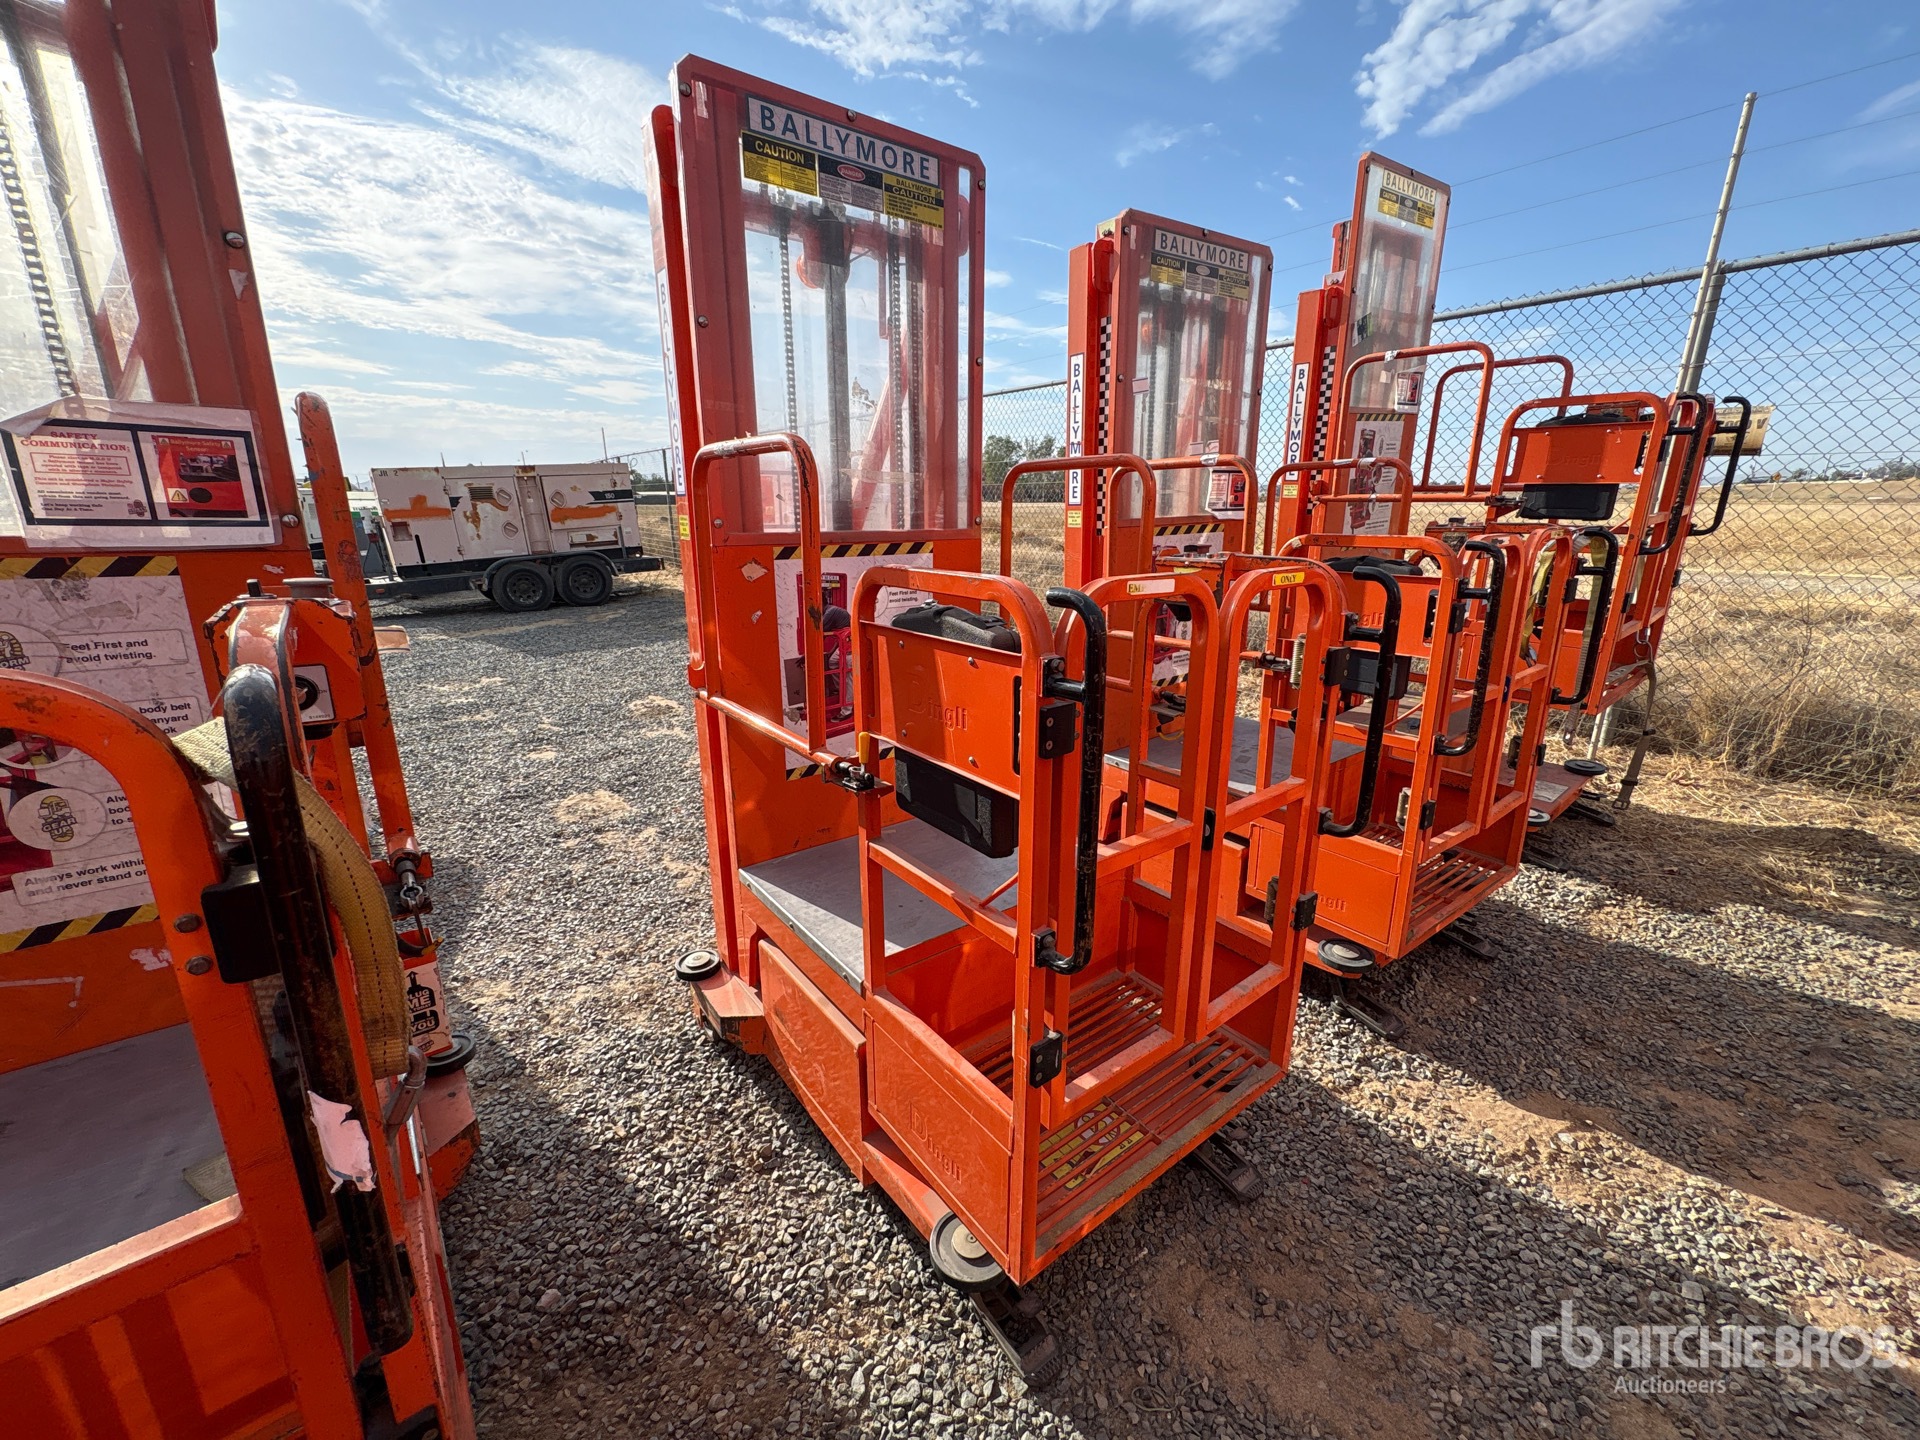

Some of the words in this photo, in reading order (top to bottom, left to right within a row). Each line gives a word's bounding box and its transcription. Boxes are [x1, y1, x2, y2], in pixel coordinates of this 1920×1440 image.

[760, 104, 930, 180] BALLYMORE
[754, 141, 805, 165] CAUTION
[896, 178, 932, 194] BALLYMORE
[1386, 172, 1433, 202] BALLYMORE
[892, 186, 936, 204] CAUTION
[1160, 232, 1245, 269] BALLYMORE
[1156, 256, 1181, 269] CAUTION
[660, 283, 683, 487] BALLYMORE
[50, 431, 98, 440] SAFETY
[1070, 363, 1081, 499] BALLYMRE
[20, 439, 130, 452] COMMUNICATION:
[1280, 575, 1297, 584] ONLY
[1361, 611, 1384, 628] gli
[93, 641, 123, 650] First
[125, 639, 149, 648] and
[0, 657, 30, 668] ORM
[66, 653, 101, 664] avoid
[104, 651, 156, 662] twisting.
[138, 704, 168, 714] body
[170, 702, 192, 711] belt
[151, 713, 189, 724] anyard
[163, 726, 177, 734] ok
[106, 795, 128, 804] Alw
[42, 817, 77, 832] GEAR
[111, 818, 124, 826] to
[54, 827, 72, 835] UP
[24, 872, 73, 887] Always
[76, 865, 108, 877] work
[26, 886, 53, 897] and
[56, 879, 94, 891] never
[96, 872, 132, 884] stand
[1319, 895, 1347, 913] ngli
[409, 989, 430, 1000] LUG
[411, 1019, 435, 1032] YOU
[909, 1100, 962, 1184] Dingli
